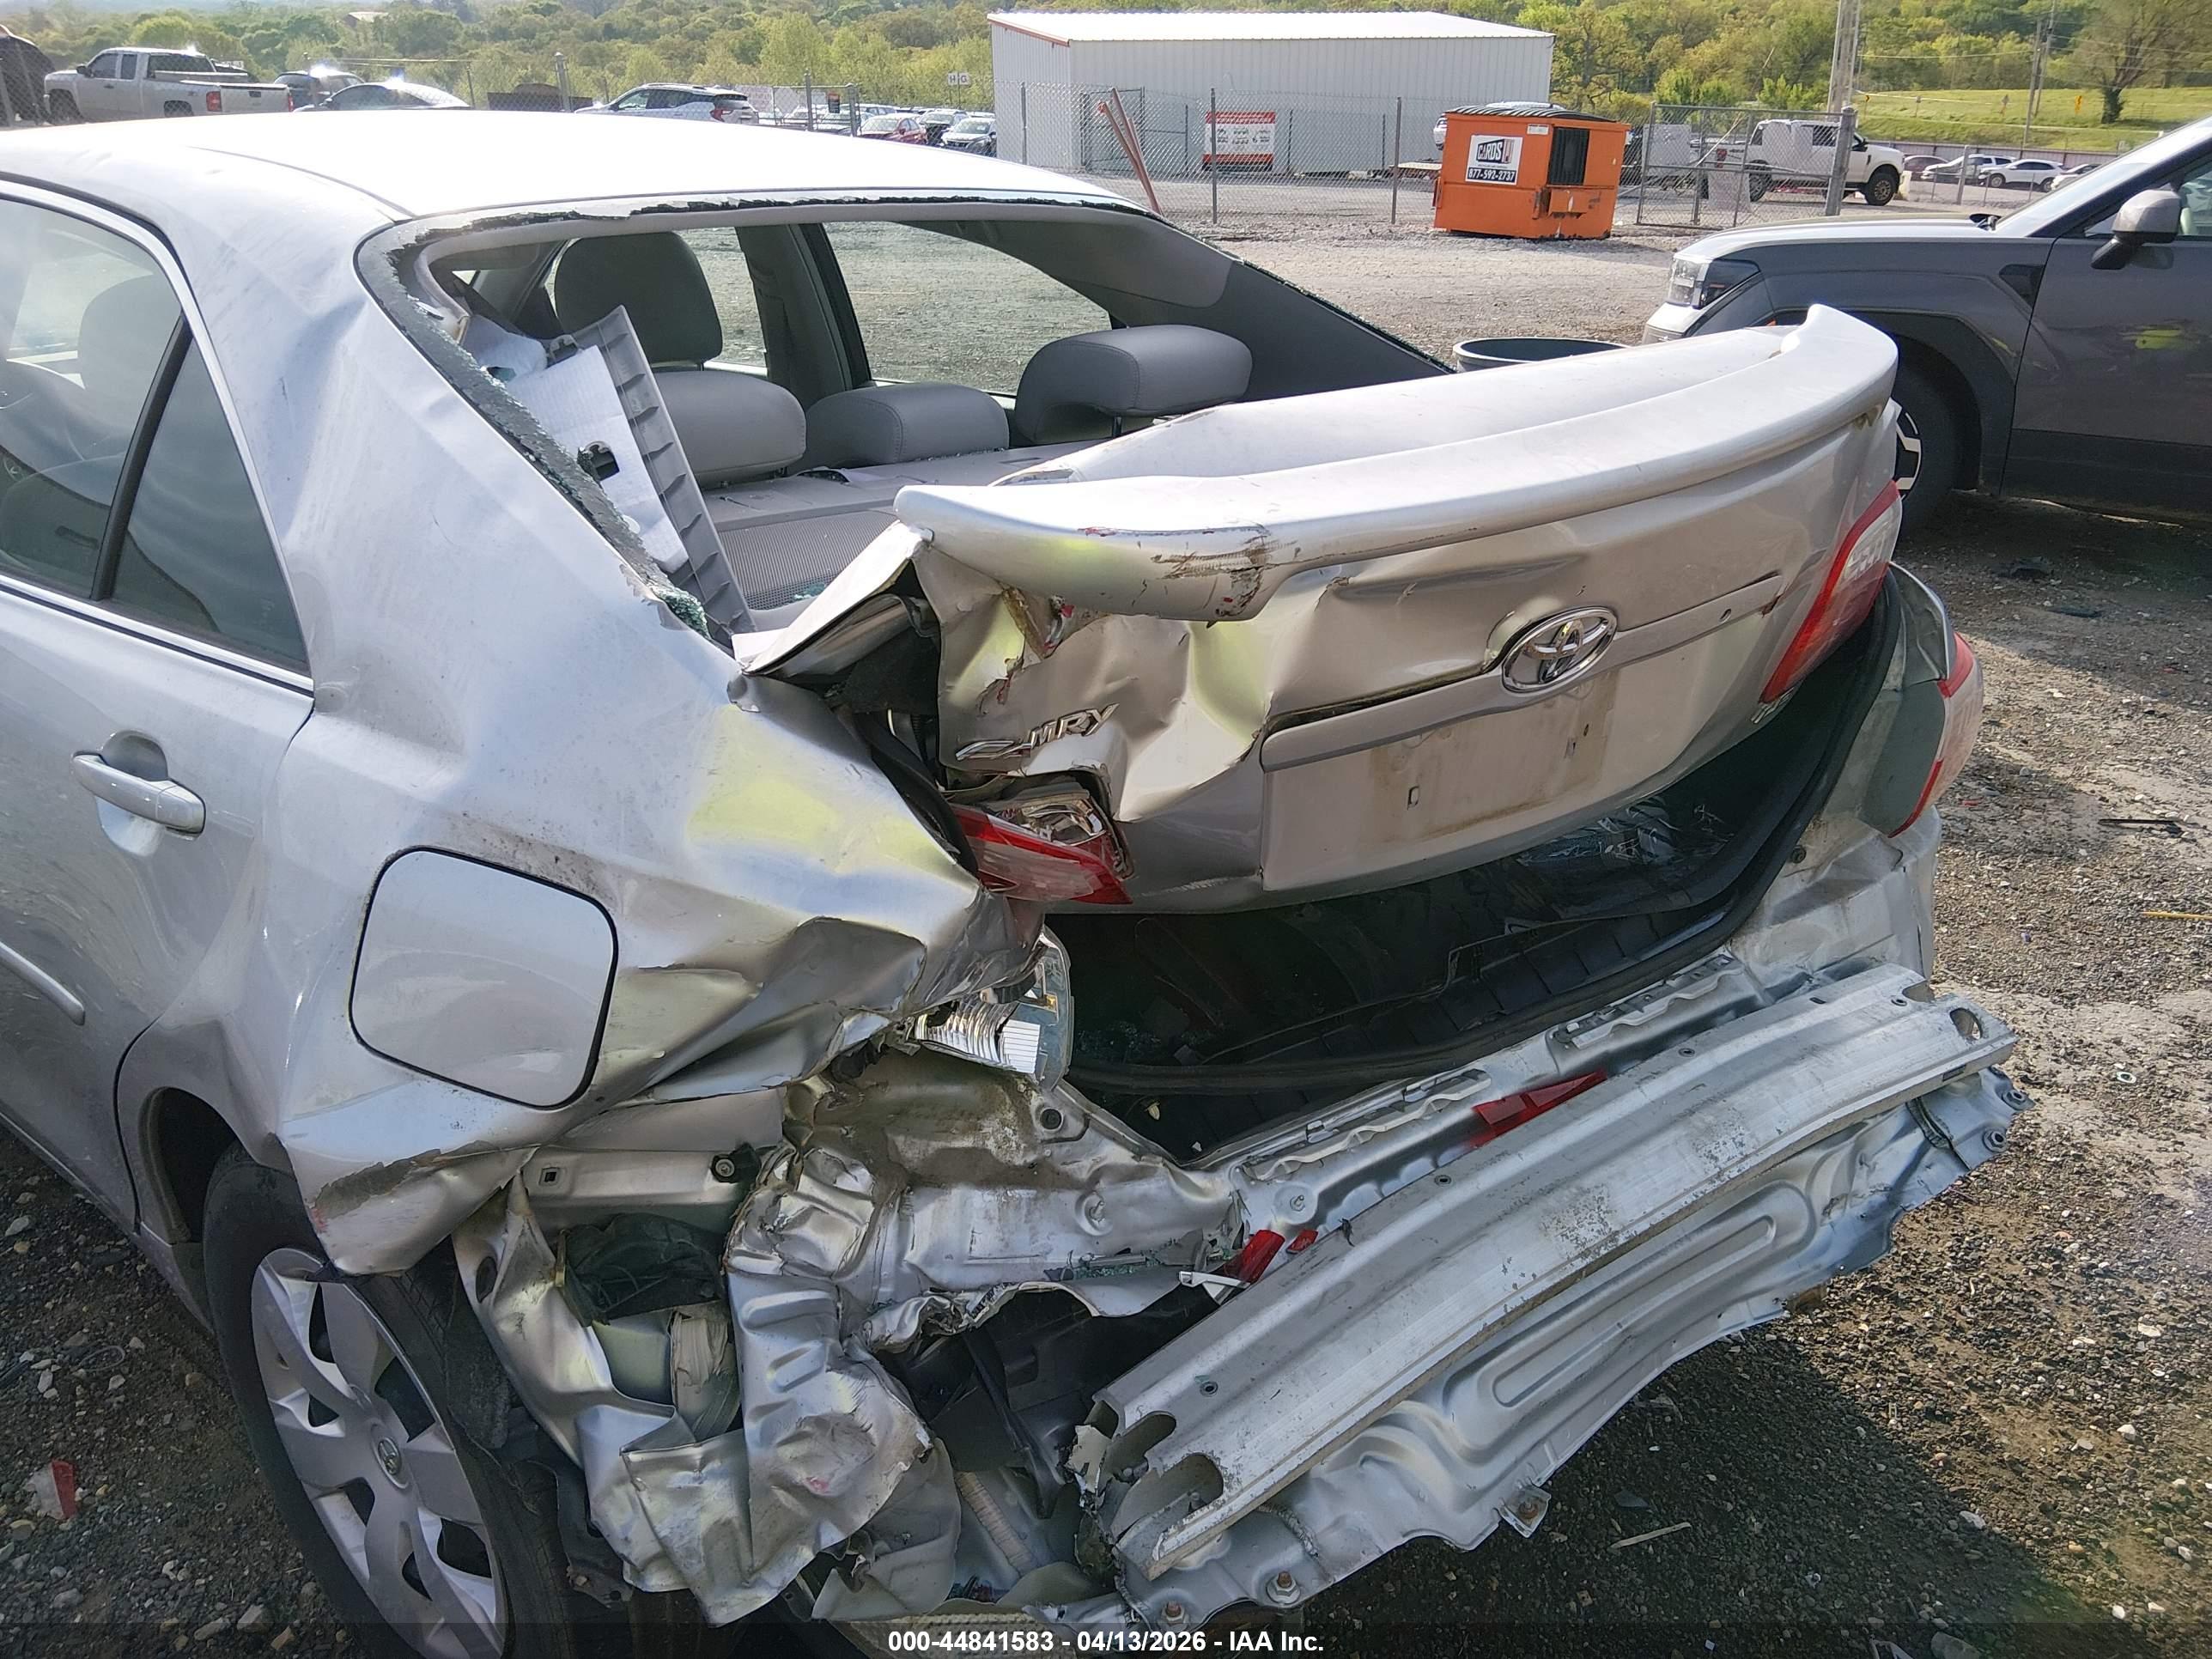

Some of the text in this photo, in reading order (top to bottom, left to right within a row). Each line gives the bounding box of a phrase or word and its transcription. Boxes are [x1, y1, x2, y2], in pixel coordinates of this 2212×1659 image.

[949, 75, 968, 83] H G
[1477, 141, 1504, 161] CARDS
[1468, 168, 1516, 181] 877-592-2737
